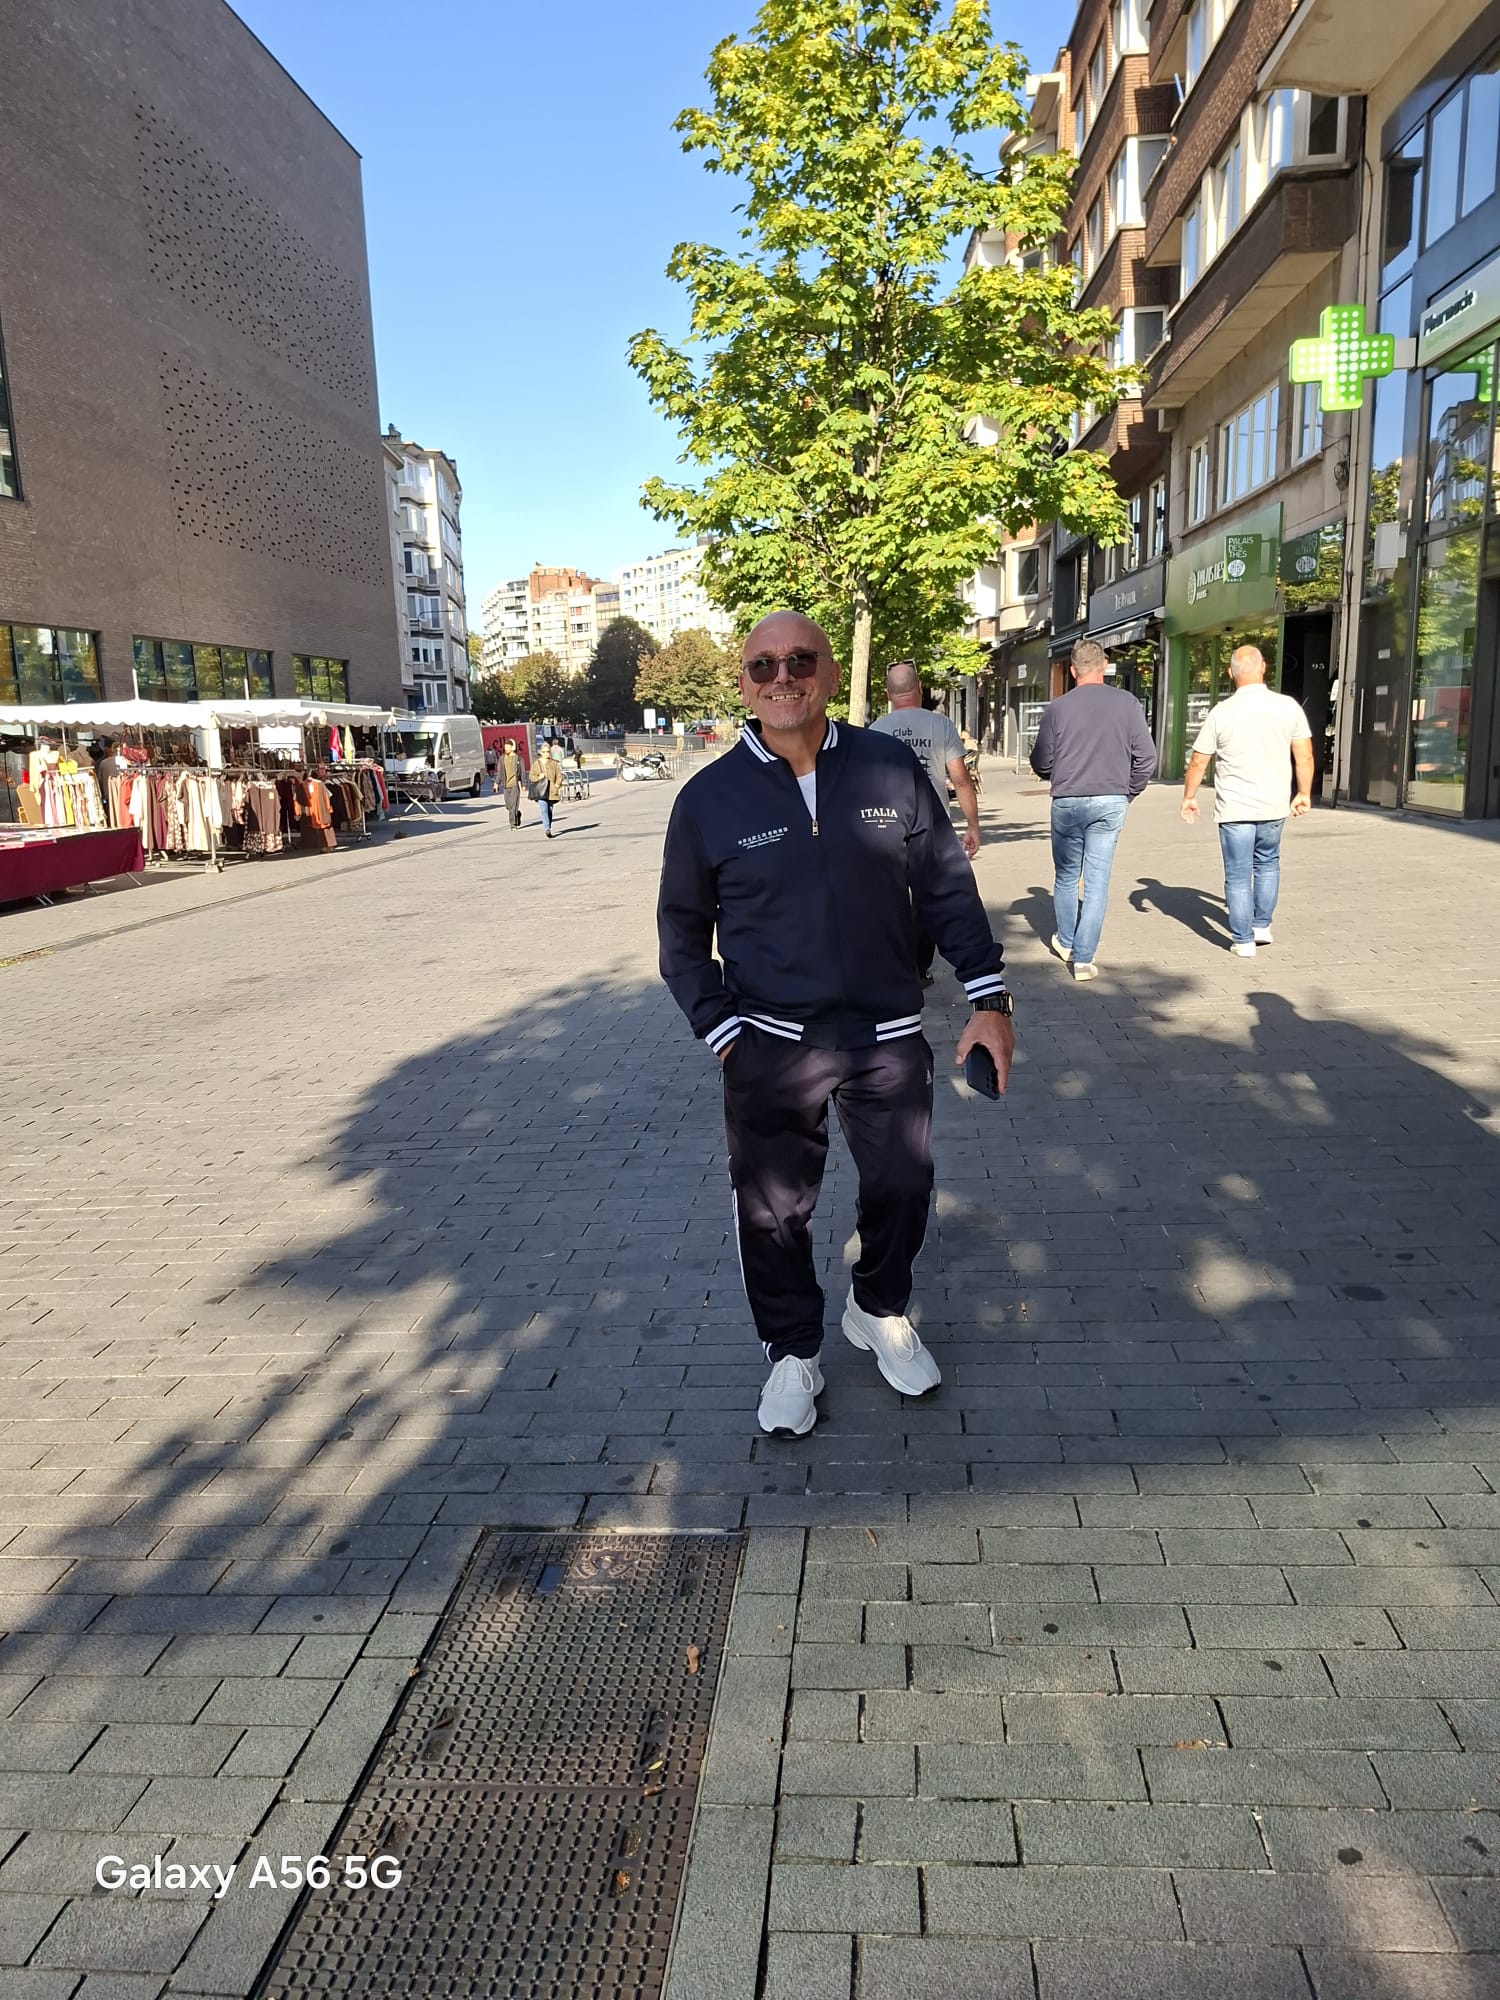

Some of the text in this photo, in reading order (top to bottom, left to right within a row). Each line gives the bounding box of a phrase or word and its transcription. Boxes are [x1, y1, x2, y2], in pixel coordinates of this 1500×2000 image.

[1228, 536, 1254, 545] PALAIS
[892, 727, 913, 738] Club
[860, 807, 899, 819] ITALIA
